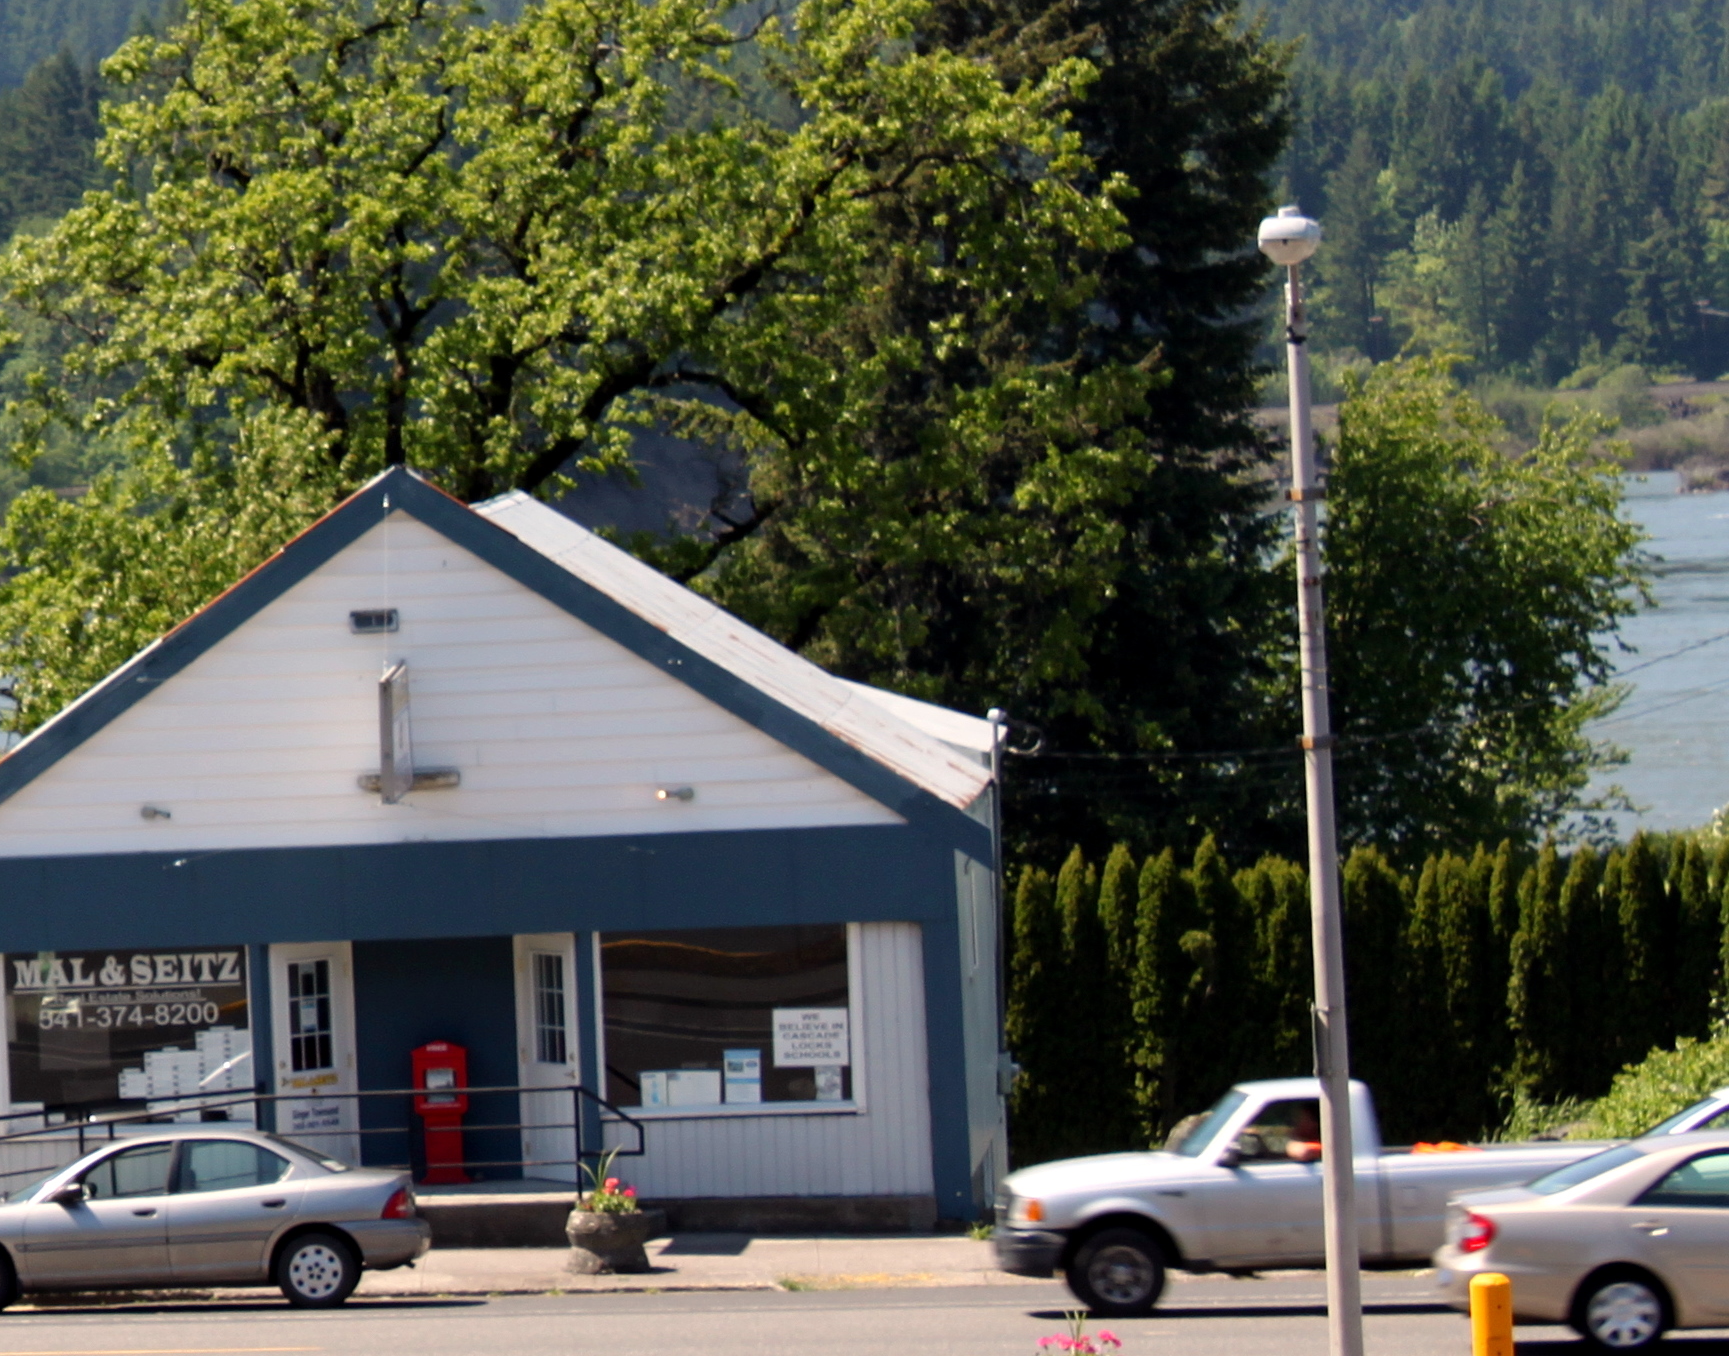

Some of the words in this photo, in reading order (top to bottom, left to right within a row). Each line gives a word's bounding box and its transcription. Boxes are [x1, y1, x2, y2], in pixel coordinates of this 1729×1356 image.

[13, 958, 95, 988] MAL
[99, 955, 126, 986] &
[130, 951, 241, 985] SEITZ
[39, 1001, 220, 1030] 541-374-8200
